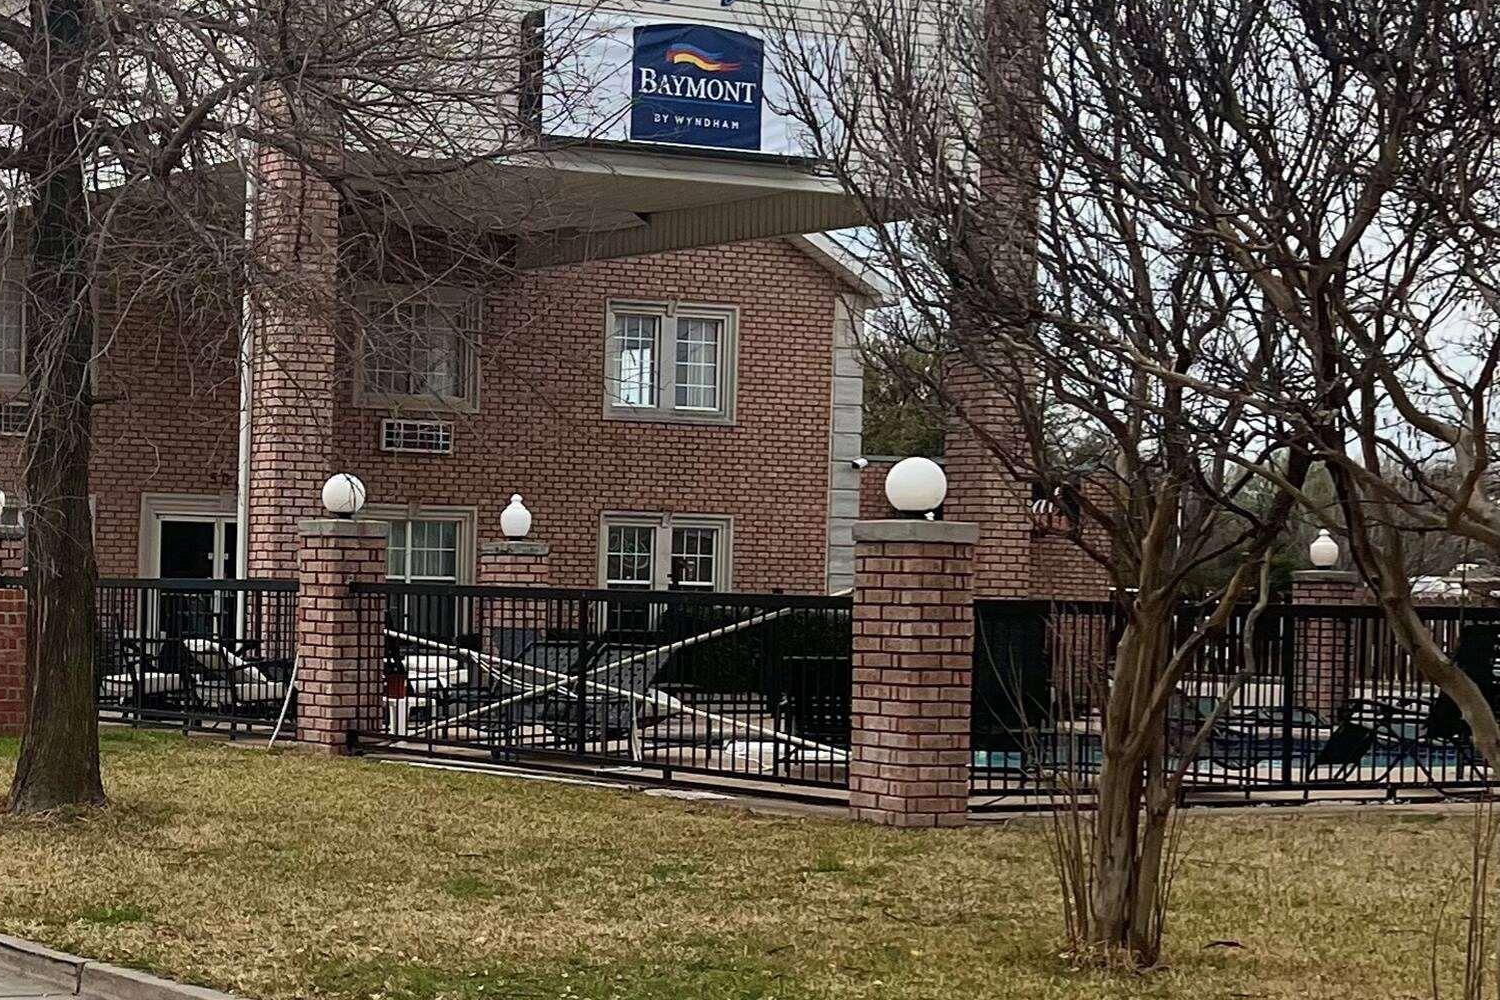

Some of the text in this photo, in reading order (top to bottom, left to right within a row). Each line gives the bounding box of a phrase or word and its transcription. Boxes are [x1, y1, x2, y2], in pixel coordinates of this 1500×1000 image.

[638, 67, 757, 104] BAYMONT
[653, 113, 740, 130] BY WYNDHAM
